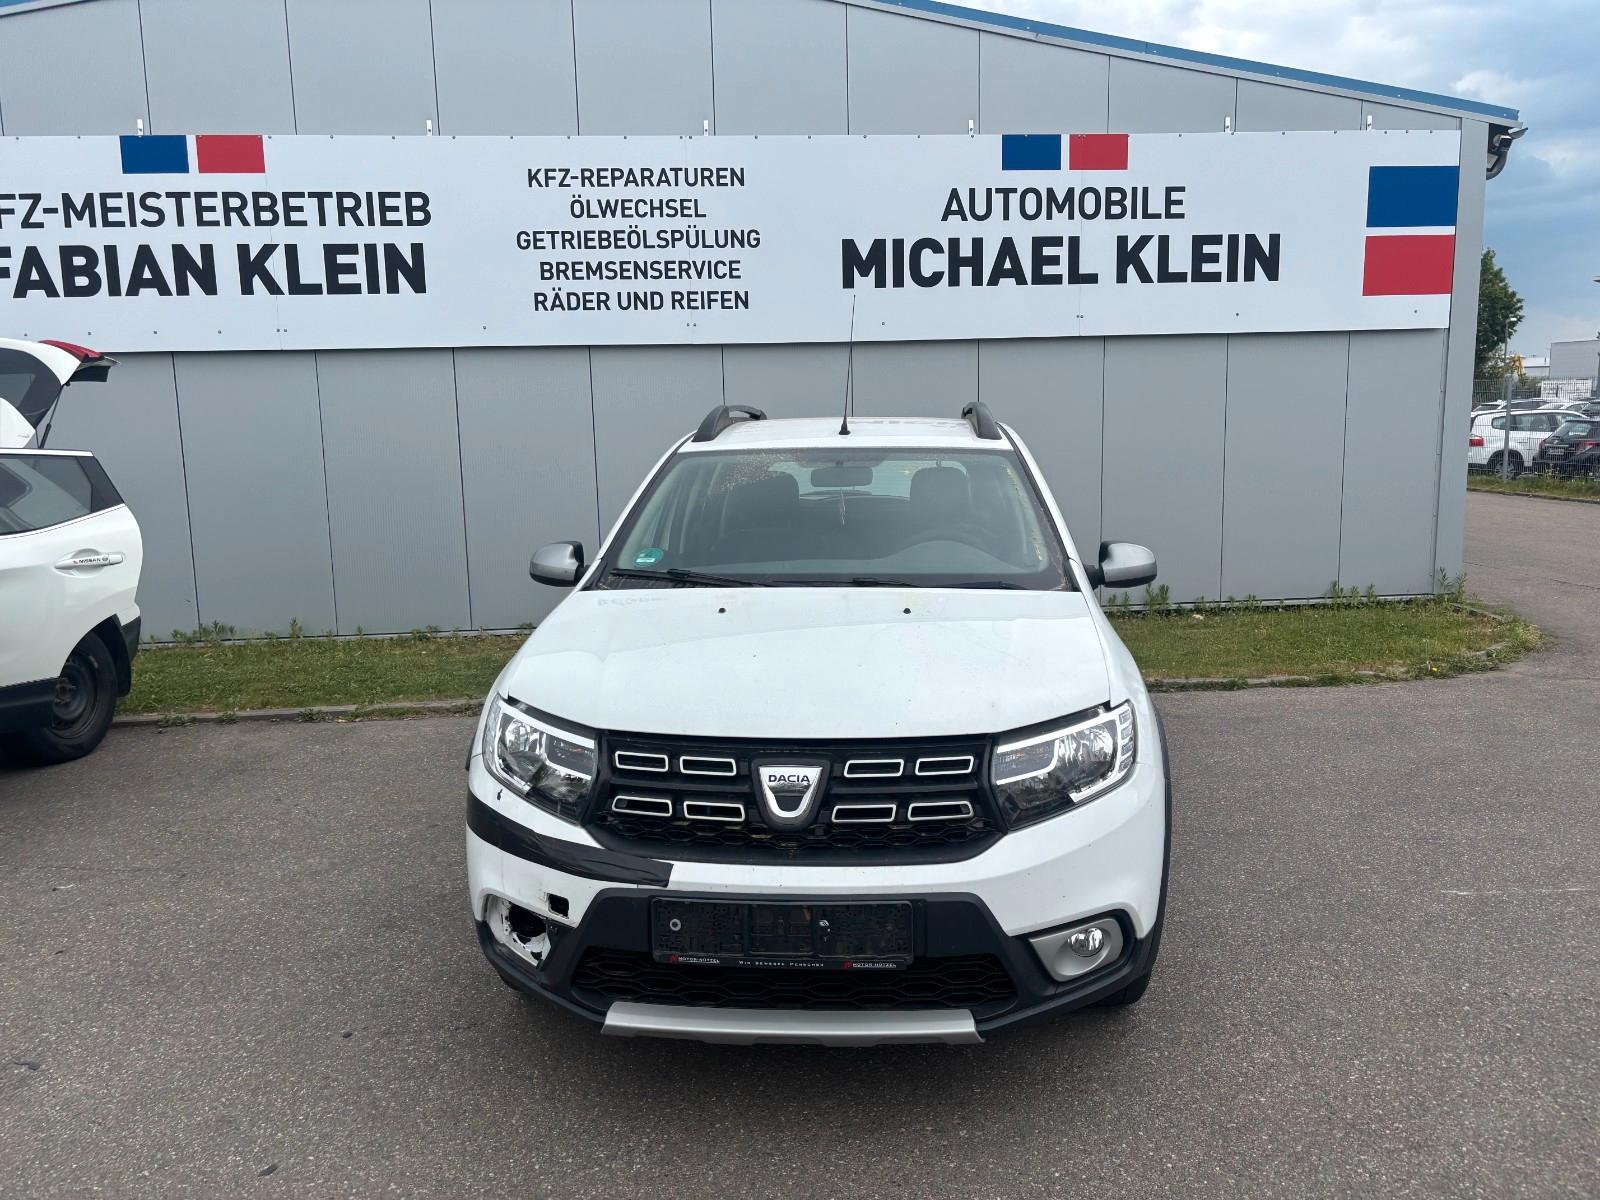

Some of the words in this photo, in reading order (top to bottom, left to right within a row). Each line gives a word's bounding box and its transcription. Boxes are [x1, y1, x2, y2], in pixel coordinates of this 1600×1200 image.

[528, 168, 745, 188] KFZ-REPARATUREN
[570, 194, 707, 219] ÖLWECHSEL
[940, 186, 1186, 222] AUTOMOBILE
[516, 225, 761, 250] GETRIEBEÖLSPÜLUNG
[0, 243, 218, 299] ABIAN
[236, 242, 427, 296] KLEIN
[540, 260, 742, 281] BREMSENSERVICE
[841, 235, 1099, 290] MICHAEL
[1115, 233, 1281, 284] KLEIN
[533, 287, 611, 312] RÄDER
[617, 291, 664, 311] UND
[670, 290, 749, 310] REIFEN
[768, 774, 810, 783] DACIA
